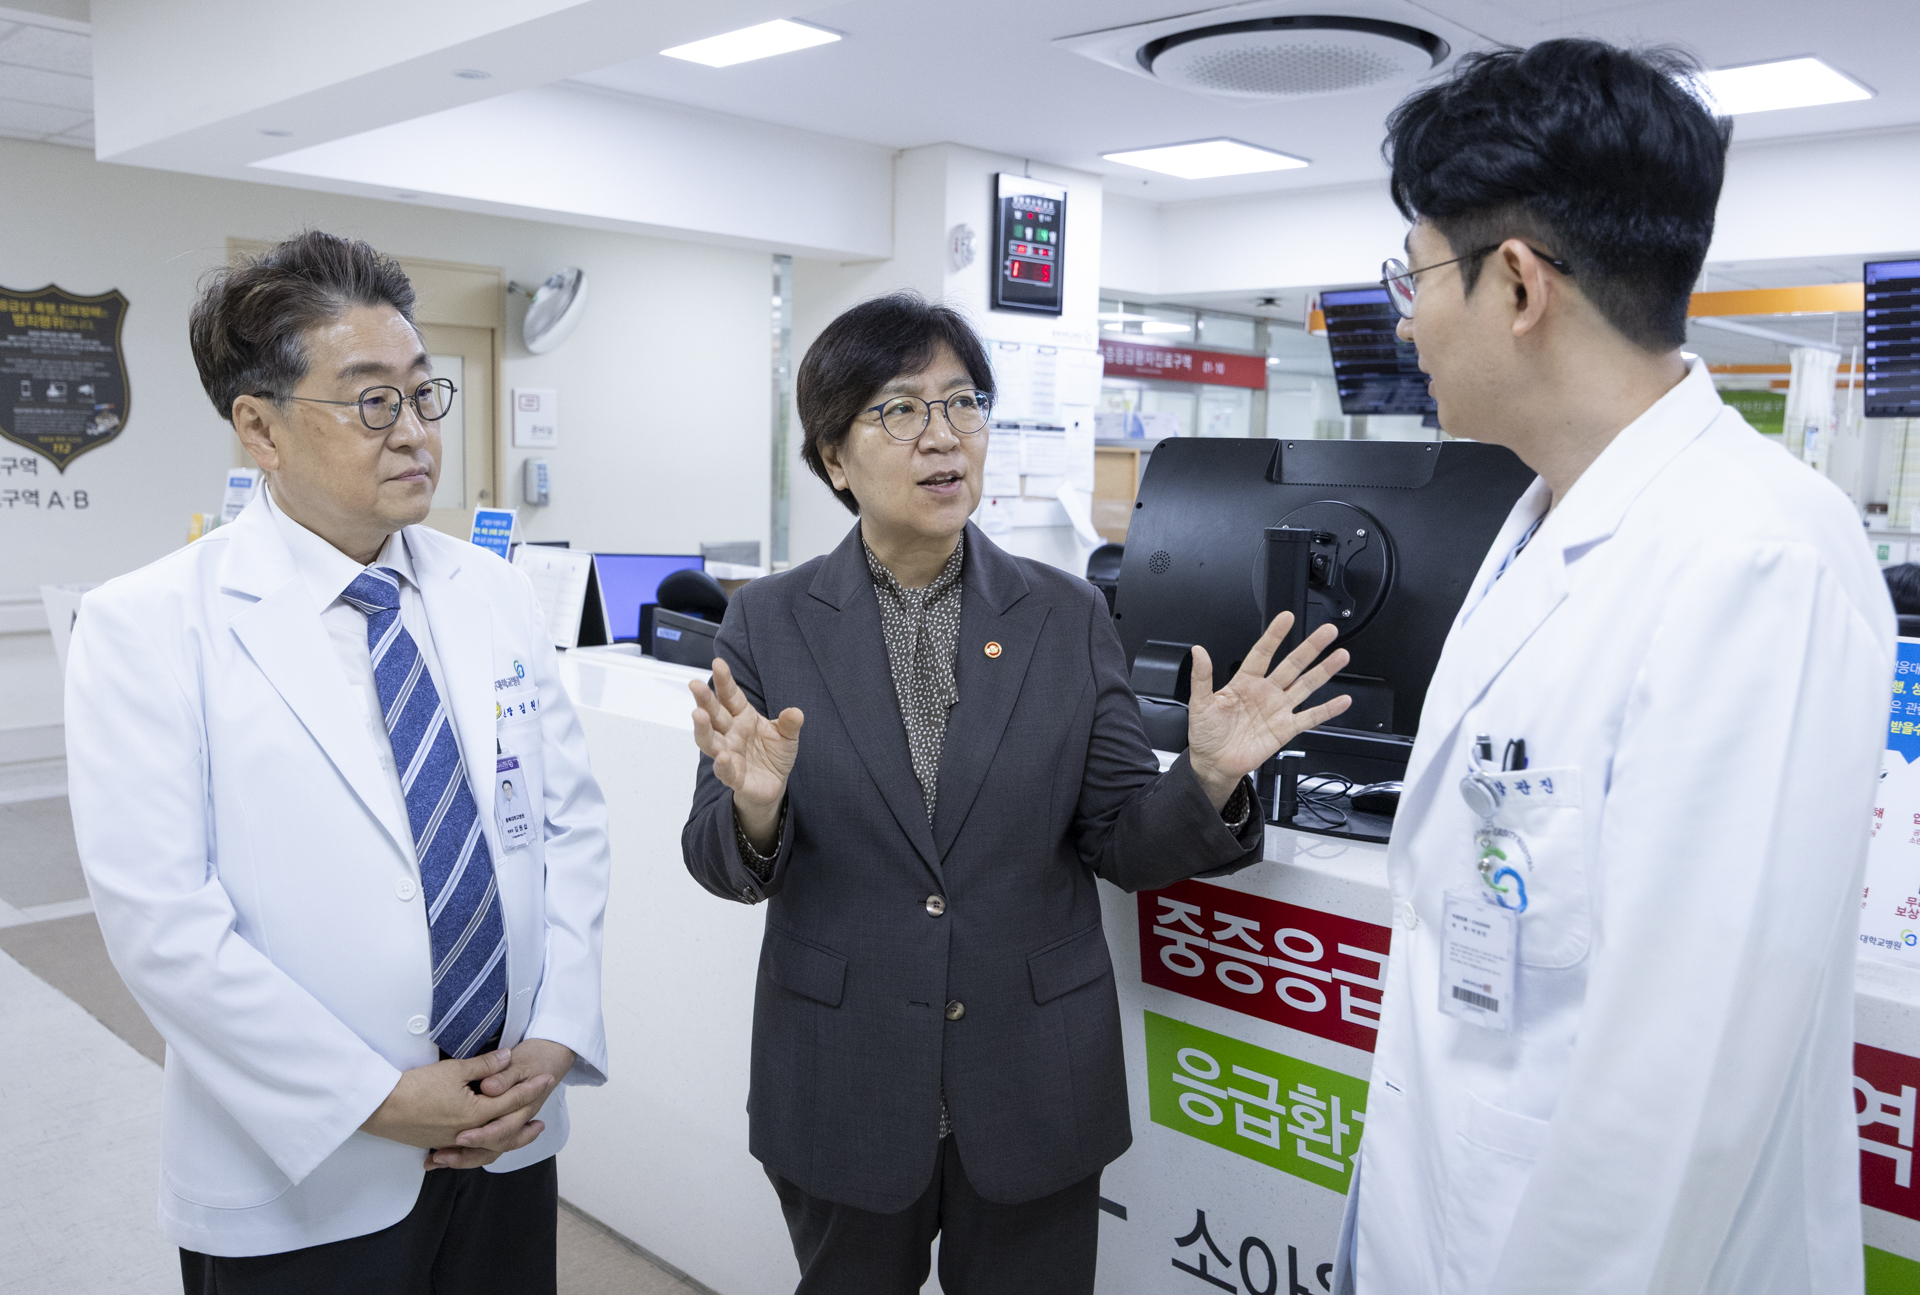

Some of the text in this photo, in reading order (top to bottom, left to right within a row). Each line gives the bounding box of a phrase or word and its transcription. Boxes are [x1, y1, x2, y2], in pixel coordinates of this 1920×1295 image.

[1153, 896, 1389, 1030] 중증응급
[1172, 1047, 1365, 1173] 응급환
[1171, 1208, 1333, 1295] 소아
